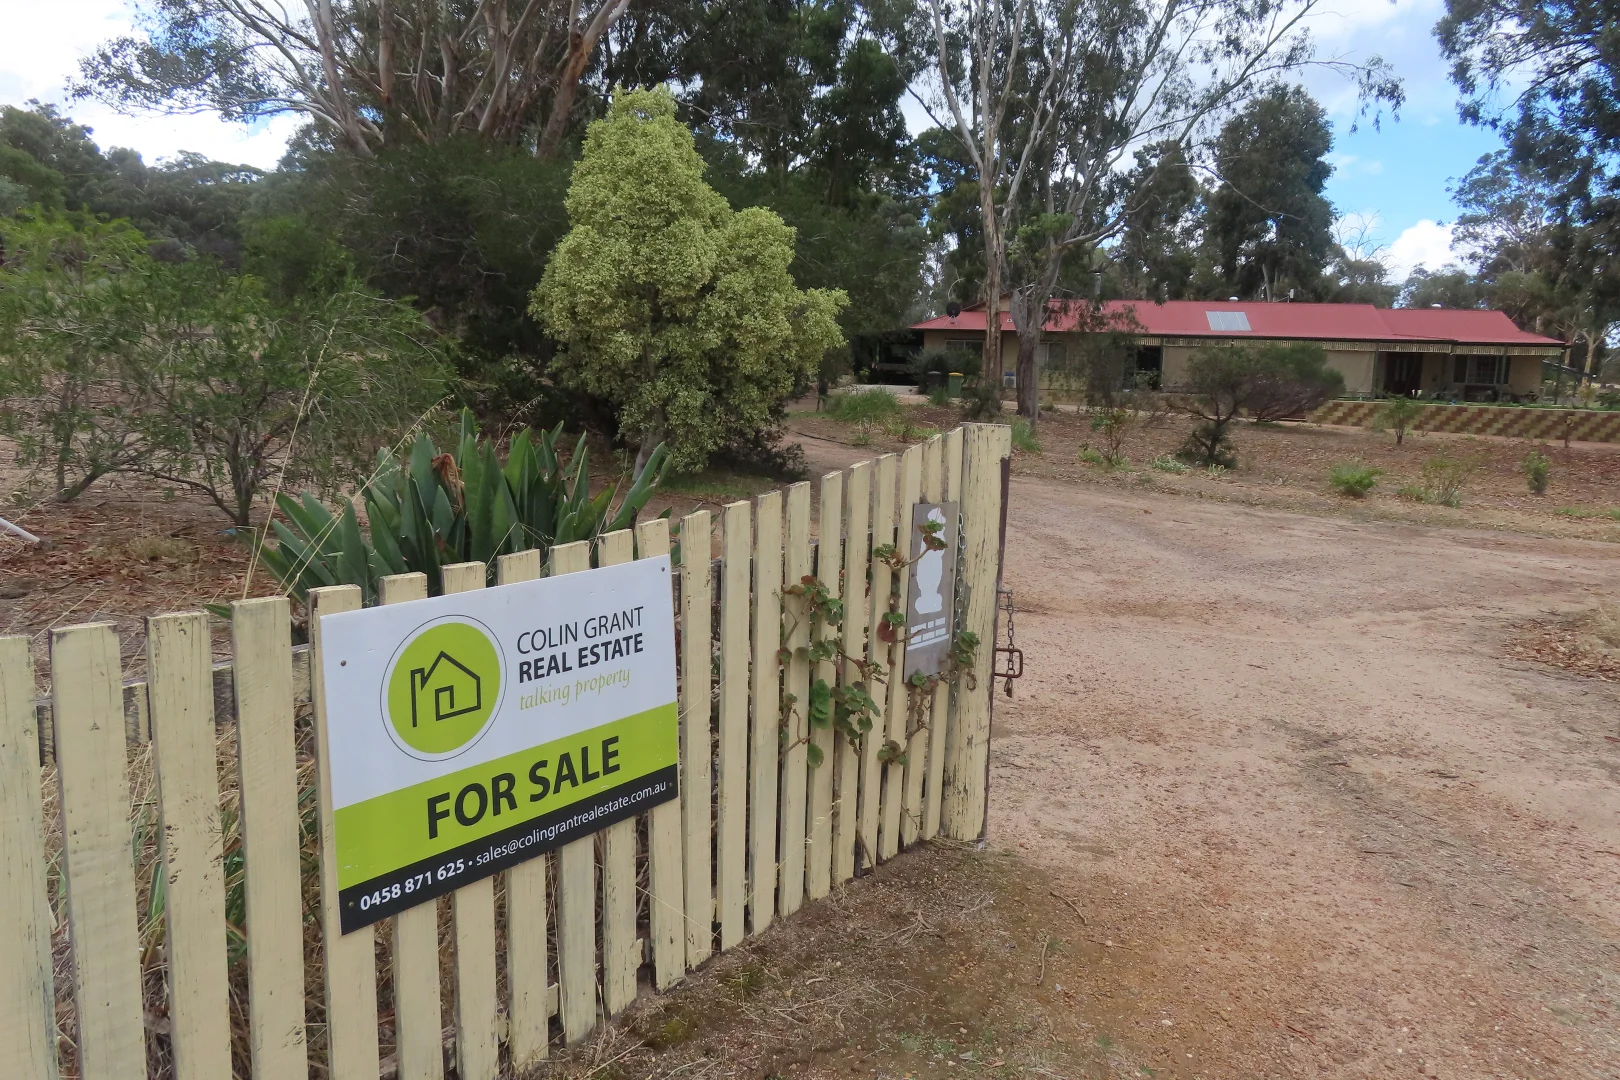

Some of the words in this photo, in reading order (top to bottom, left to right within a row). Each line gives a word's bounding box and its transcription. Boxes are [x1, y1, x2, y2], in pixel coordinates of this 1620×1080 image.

[517, 620, 578, 655] COLIN
[583, 606, 644, 640] GRANT
[518, 652, 573, 683] REAL
[578, 632, 644, 668] ESTATE
[519, 681, 570, 710] talking
[575, 667, 631, 697] property
[427, 772, 518, 840] FOR
[529, 735, 621, 803] SALE
[360, 882, 402, 911] 0458
[404, 870, 433, 894] 871
[437, 858, 466, 882] 625
[475, 780, 667, 867] sales@colingrantrealestate.com.au
